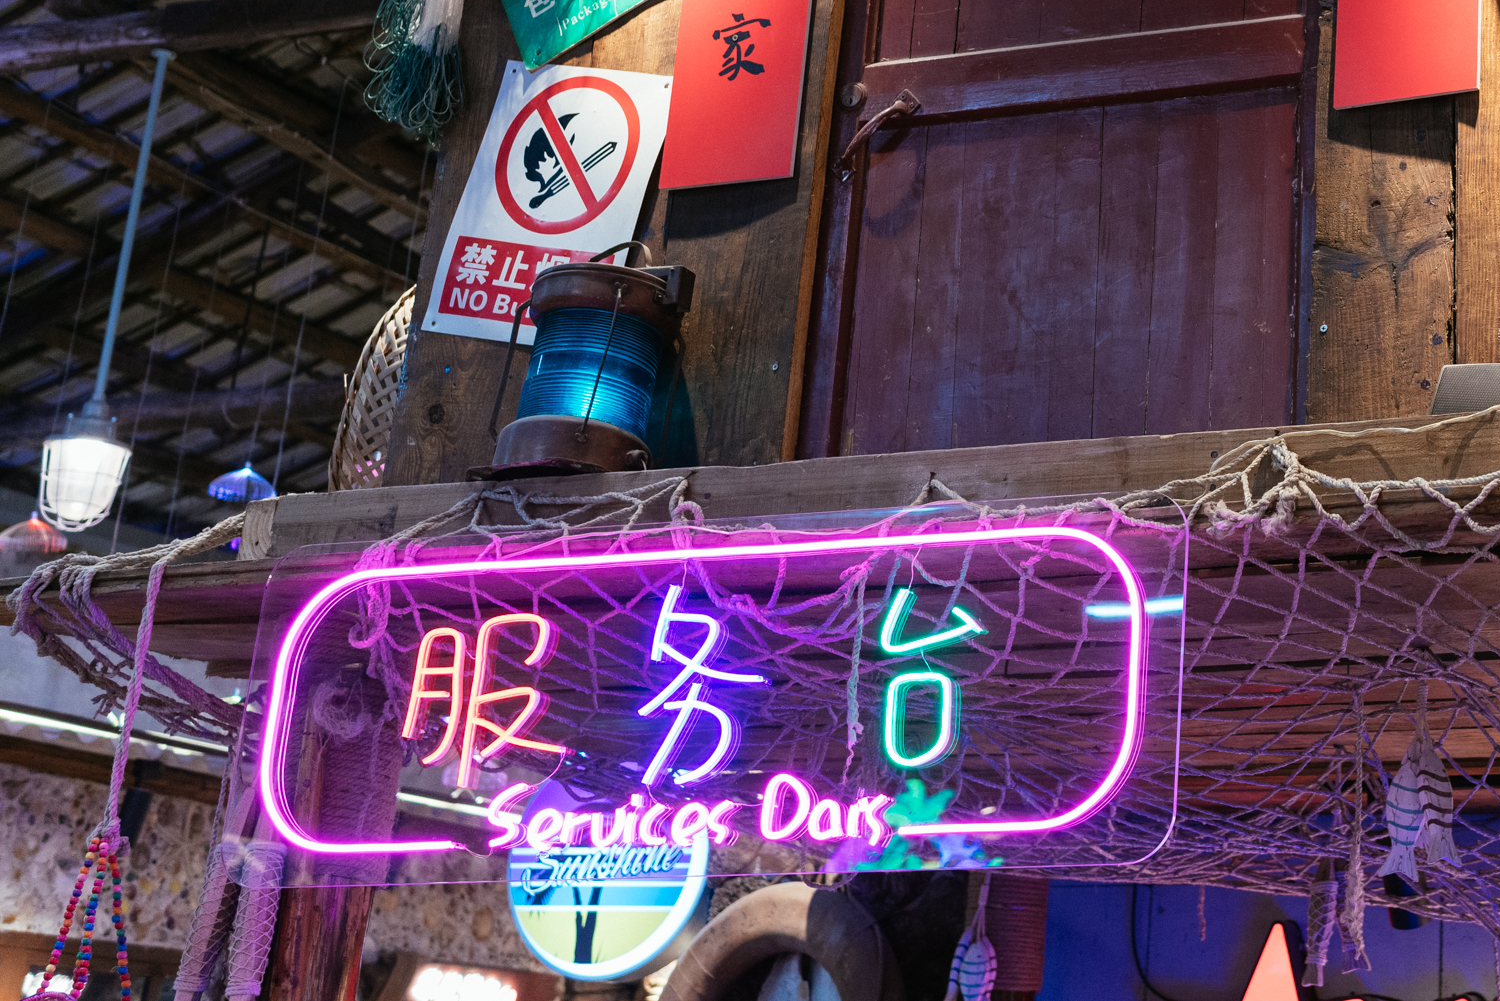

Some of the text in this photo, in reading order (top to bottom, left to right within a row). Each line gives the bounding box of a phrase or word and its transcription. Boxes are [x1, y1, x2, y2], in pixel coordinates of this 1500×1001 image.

[449, 287, 488, 311] NO
[402, 584, 988, 788] 服务台
[487, 782, 738, 848] Services
